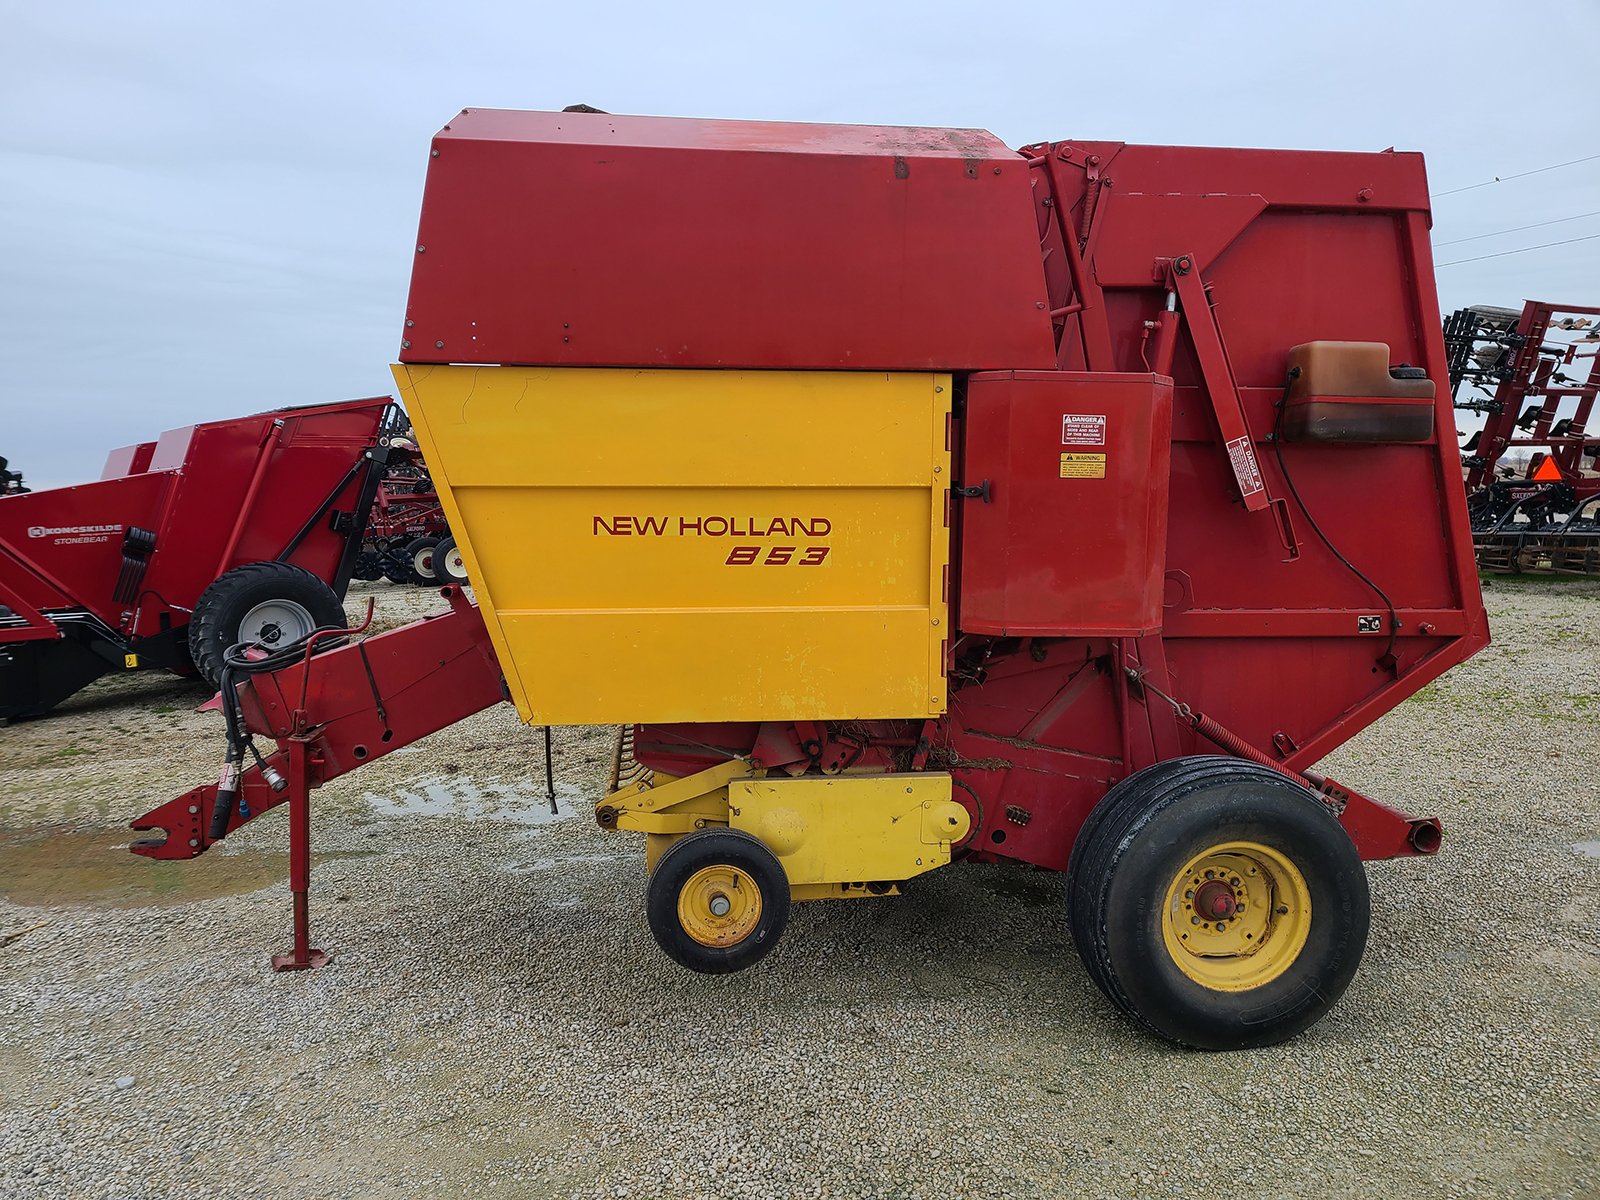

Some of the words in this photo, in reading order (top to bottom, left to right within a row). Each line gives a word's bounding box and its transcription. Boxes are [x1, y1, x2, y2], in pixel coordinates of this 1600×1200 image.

[1245, 450, 1258, 477] DANGER
[46, 524, 123, 535] KONGSKILDE
[592, 516, 668, 536] NEW
[679, 516, 832, 536] HOLLAND
[54, 536, 108, 545] STONEBEAR
[724, 546, 831, 566] 853
